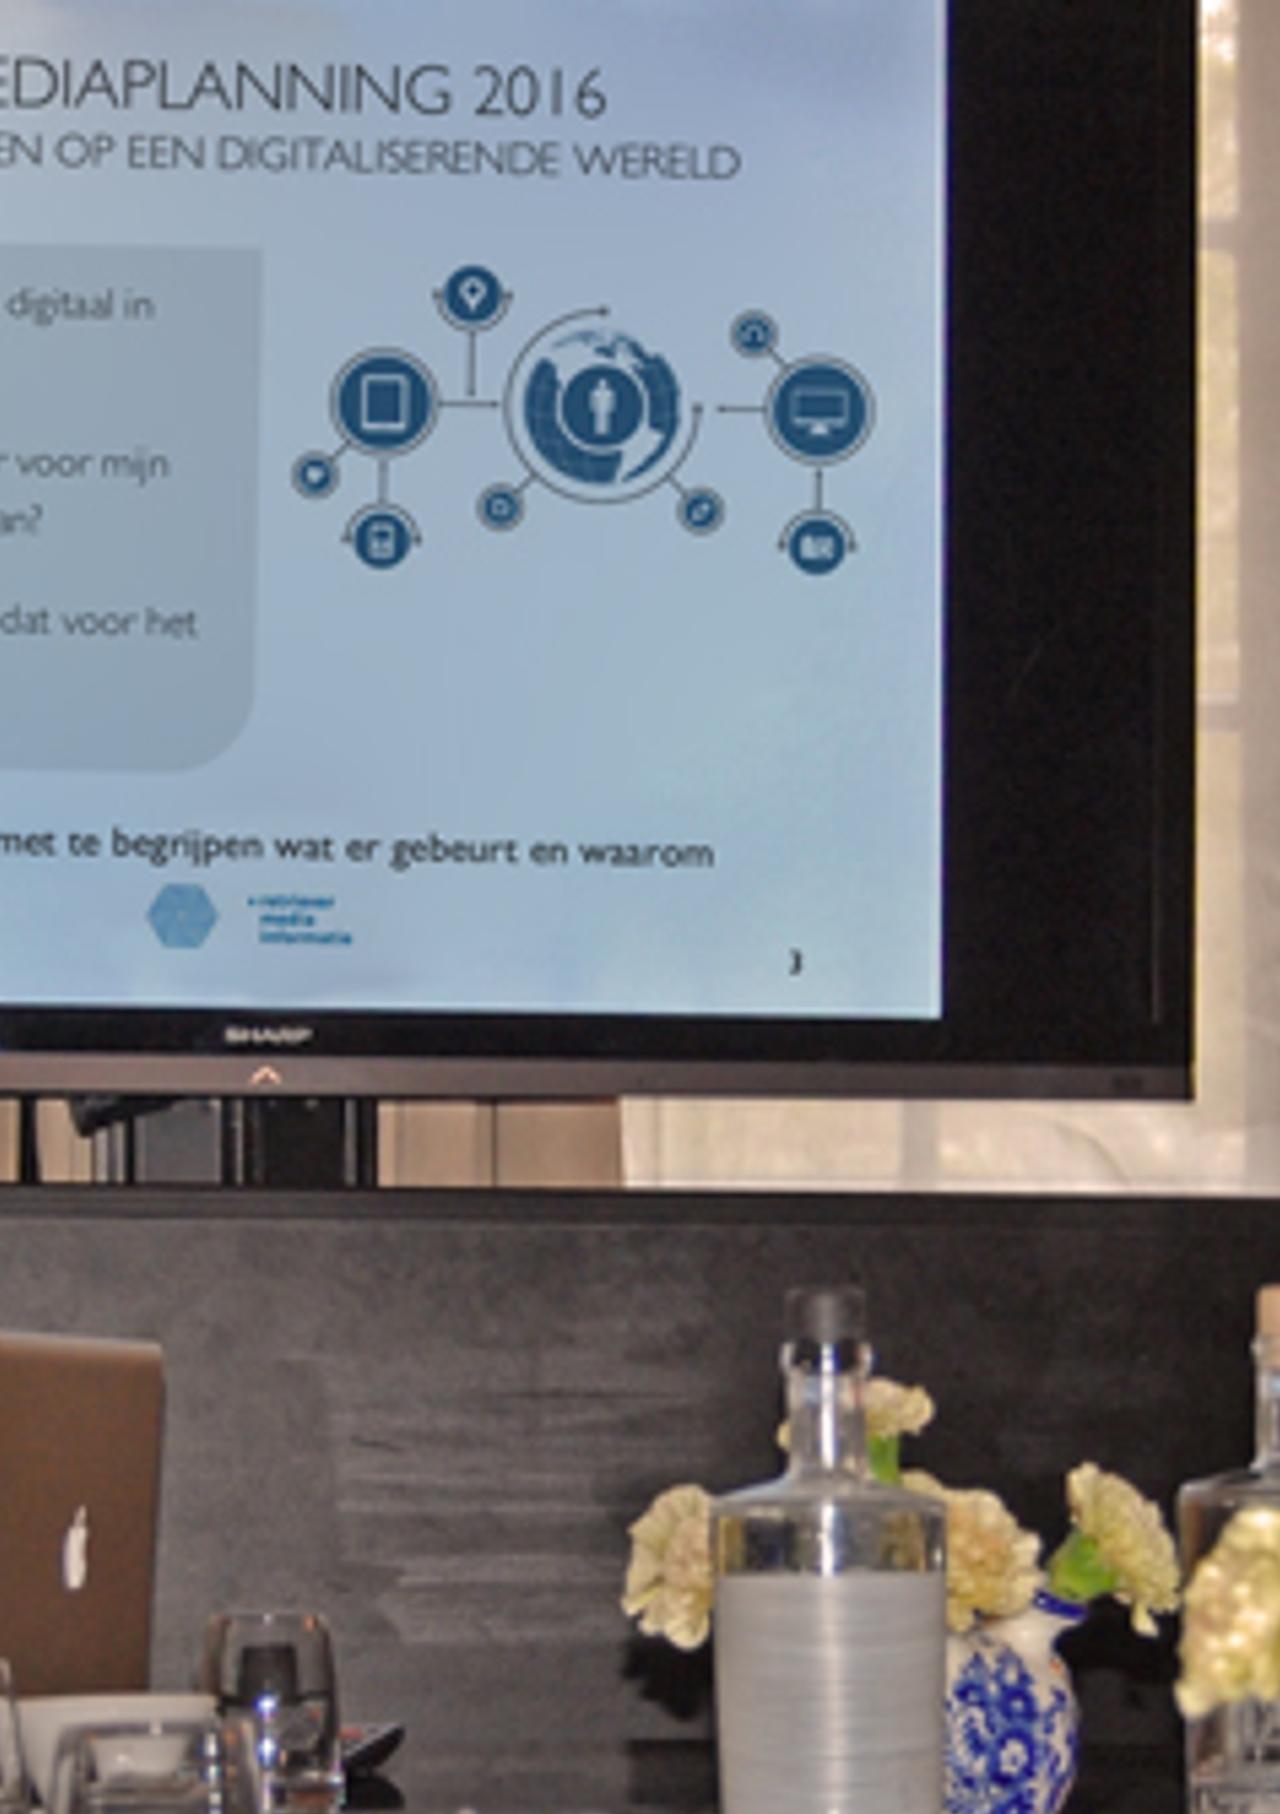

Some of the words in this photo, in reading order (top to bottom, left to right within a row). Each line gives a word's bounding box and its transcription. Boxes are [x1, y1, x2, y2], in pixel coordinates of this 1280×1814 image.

[474, 63, 608, 119] 2016
[54, 130, 118, 170] OP
[127, 133, 206, 172] EEN
[218, 134, 560, 177] DIGITALISERENDE
[572, 141, 743, 181] WERELD
[6, 287, 115, 327] digitaal
[124, 289, 156, 320] in
[18, 451, 93, 478] voor
[102, 446, 170, 487] mijn
[63, 609, 138, 638] voor
[145, 605, 200, 640] het
[67, 828, 102, 857] te
[111, 825, 266, 866] begrijpen
[274, 833, 335, 862] wat
[344, 837, 382, 863] er
[388, 831, 520, 872] gebeurt
[528, 839, 570, 866] en
[577, 840, 716, 869] waarom
[224, 1025, 313, 1046] SHARP
